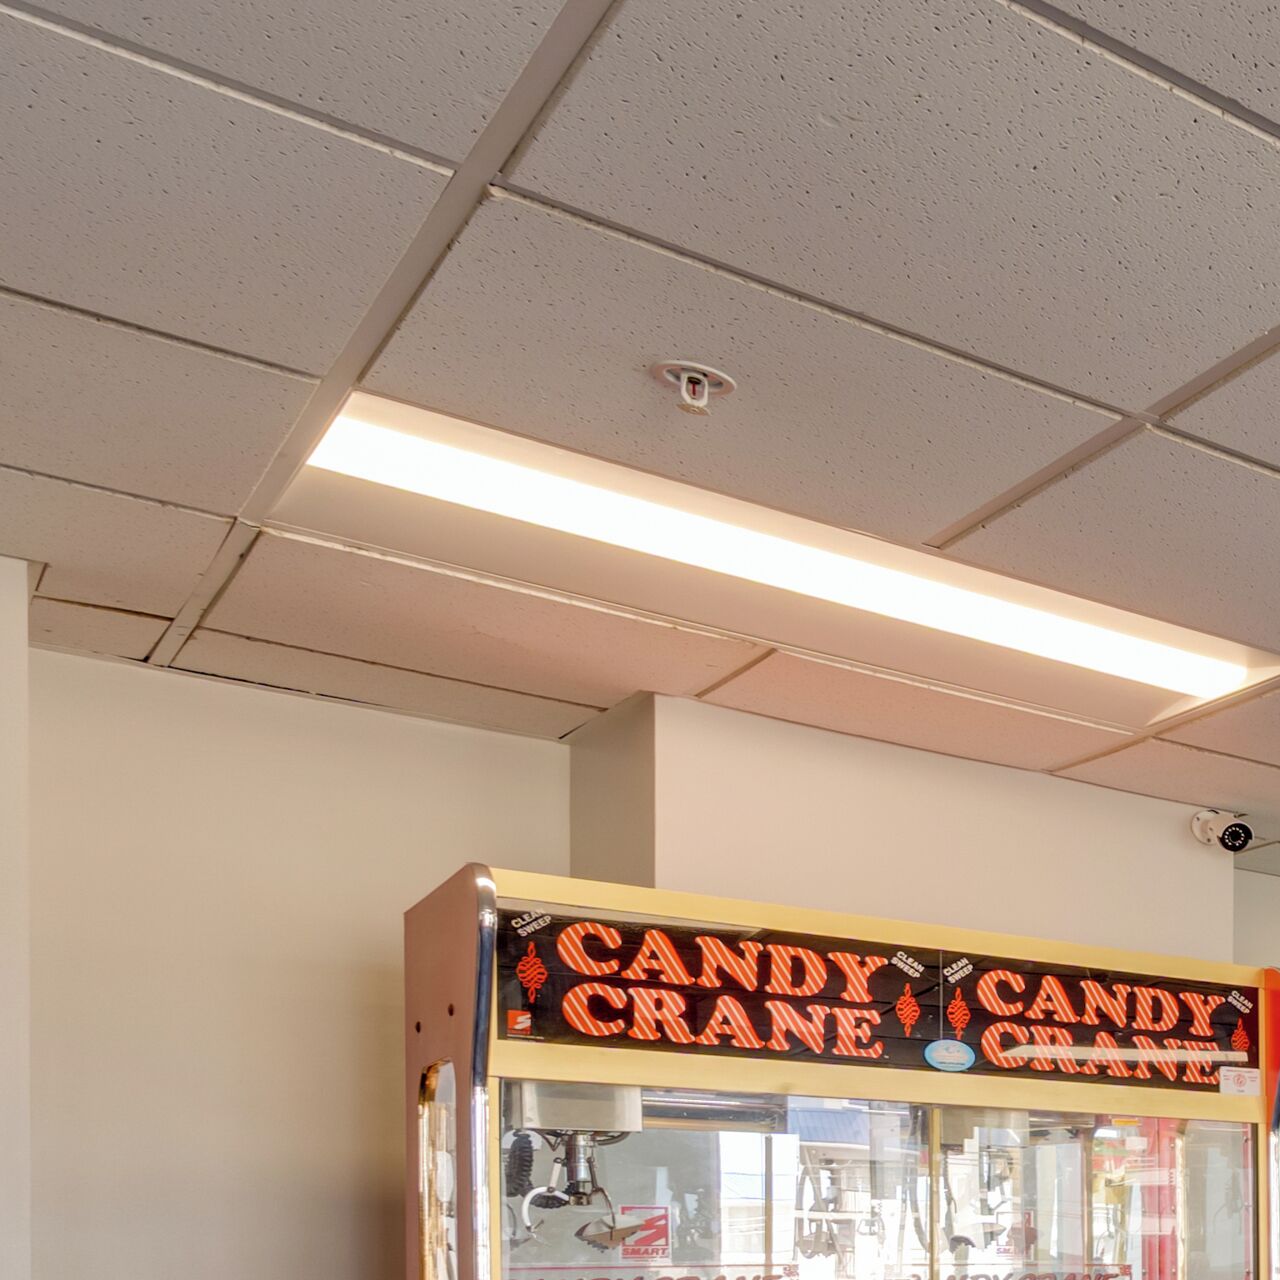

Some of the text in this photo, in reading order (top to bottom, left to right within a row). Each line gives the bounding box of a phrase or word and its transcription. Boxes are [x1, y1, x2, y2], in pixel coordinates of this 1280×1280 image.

[511, 909, 546, 928] CLEAN
[517, 915, 552, 937] SWEEP
[556, 921, 888, 1003] CANDY
[890, 956, 920, 978] SWEEP
[896, 951, 925, 973] CLEAN
[943, 957, 969, 976] CLEAN
[947, 964, 974, 984] SWEEP
[976, 969, 1226, 1037] CANDY
[1227, 995, 1250, 1014] SWEEP
[1231, 990, 1253, 1009] CLEAN
[561, 982, 886, 1059] CRANE
[980, 1022, 1220, 1085] CRANE
[622, 1247, 668, 1257] SMART
